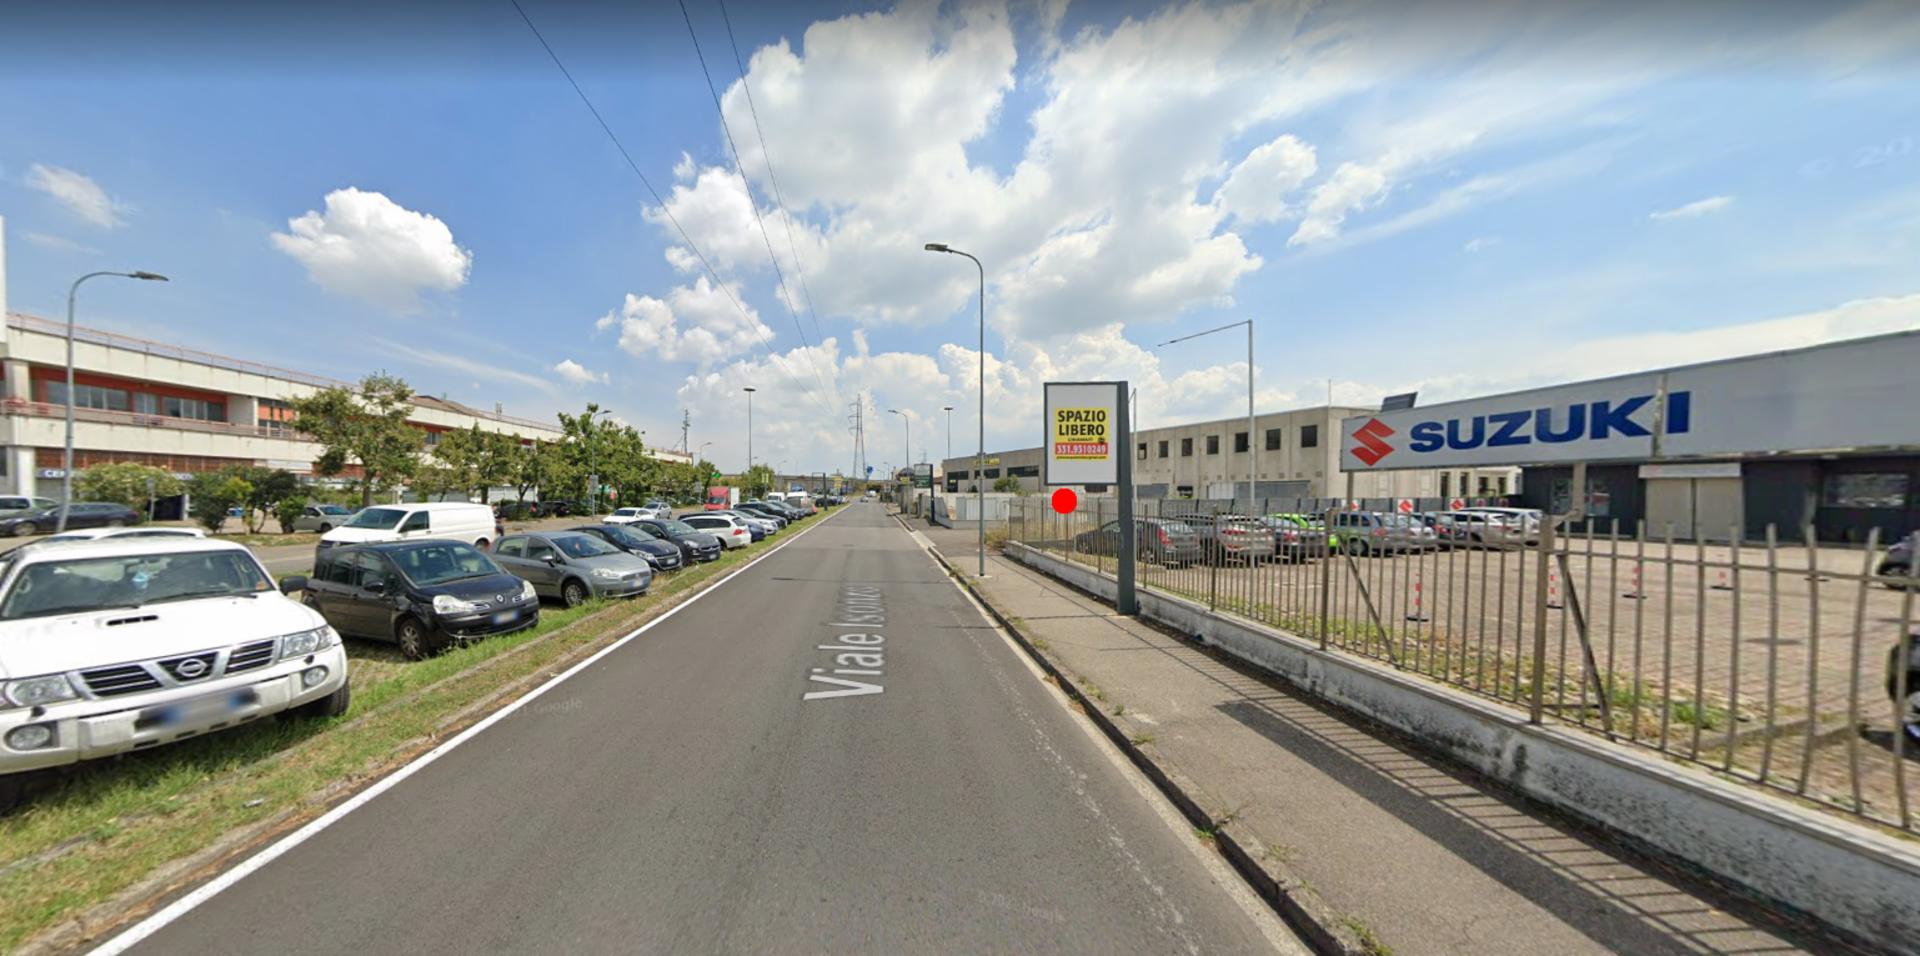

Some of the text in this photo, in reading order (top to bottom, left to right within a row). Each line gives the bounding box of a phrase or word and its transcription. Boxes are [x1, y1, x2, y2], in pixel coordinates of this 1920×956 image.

[1057, 409, 1107, 423] SPAZIO
[1409, 391, 1691, 453] SUZUKI
[1058, 424, 1105, 436] LIBERO
